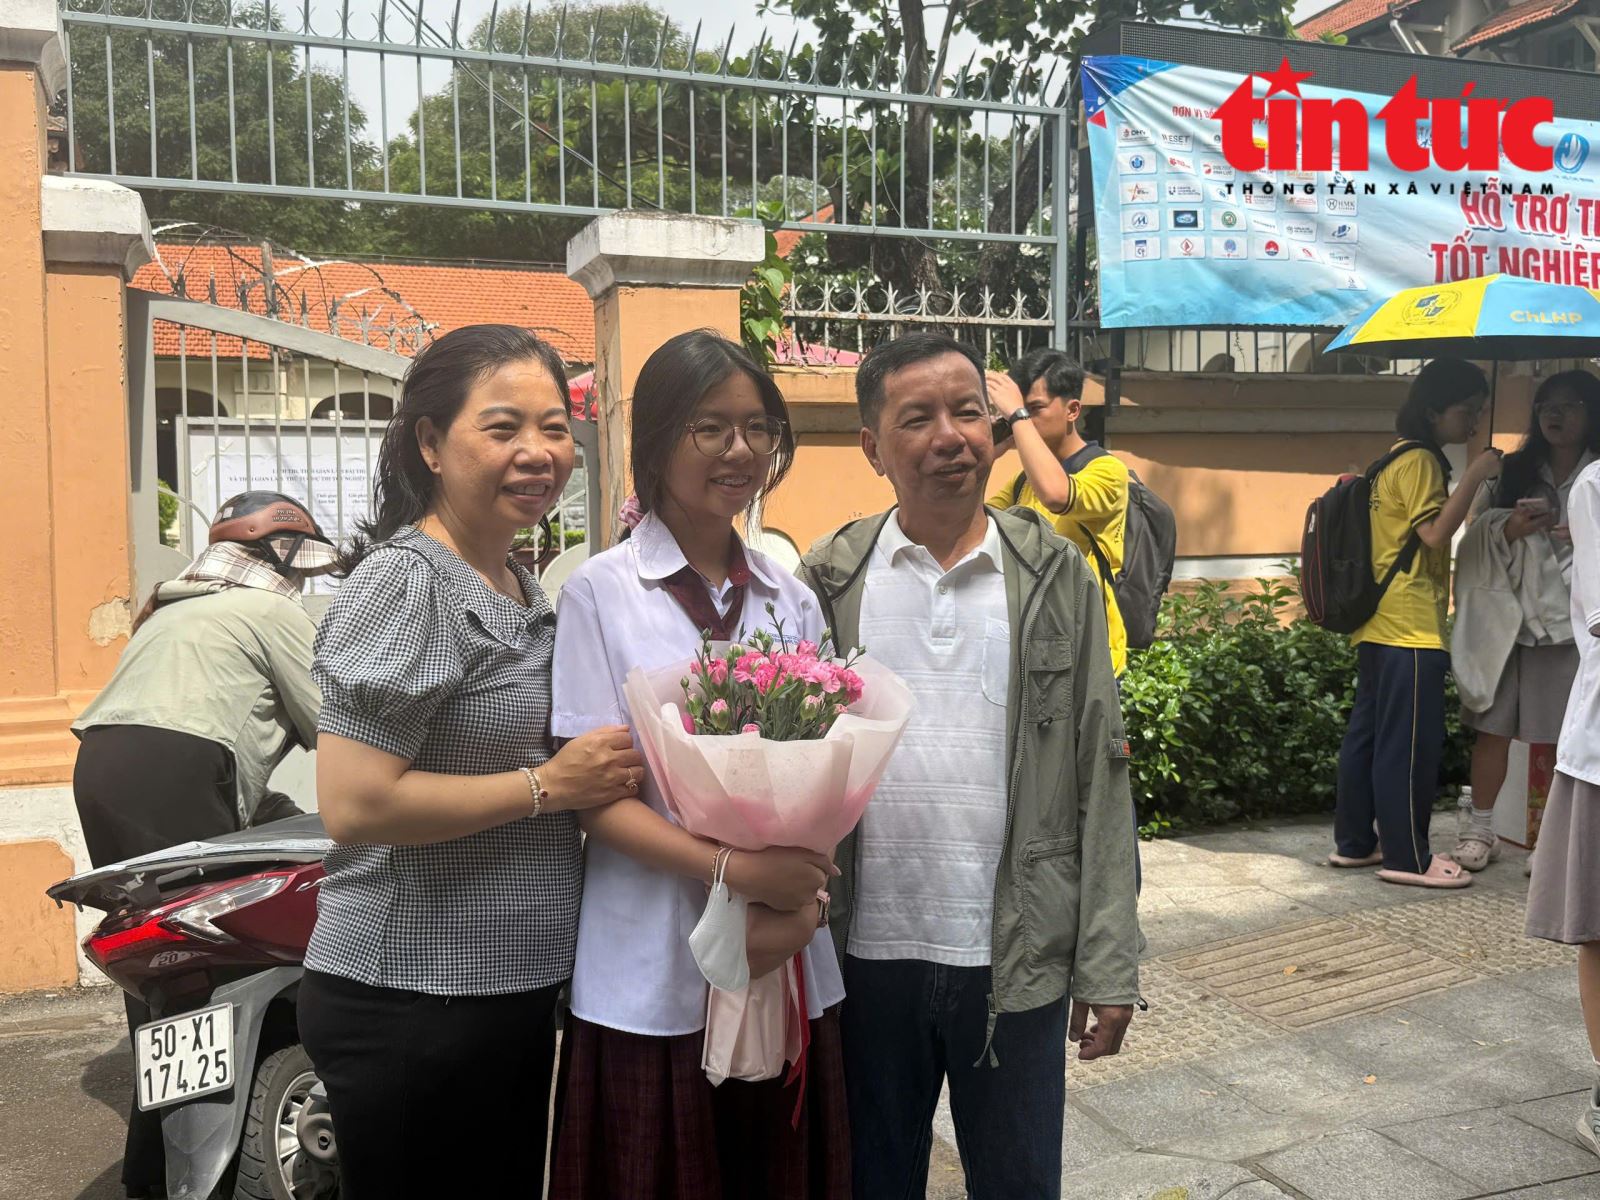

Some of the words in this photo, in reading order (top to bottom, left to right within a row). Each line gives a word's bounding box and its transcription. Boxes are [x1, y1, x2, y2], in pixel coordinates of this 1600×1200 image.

[1460, 177, 1504, 228] HỖ
[1512, 193, 1570, 241] TRỢ
[1431, 230, 1488, 284] TỐT
[151, 1013, 215, 1061] 50-X1
[144, 1049, 228, 1103] 174.25
